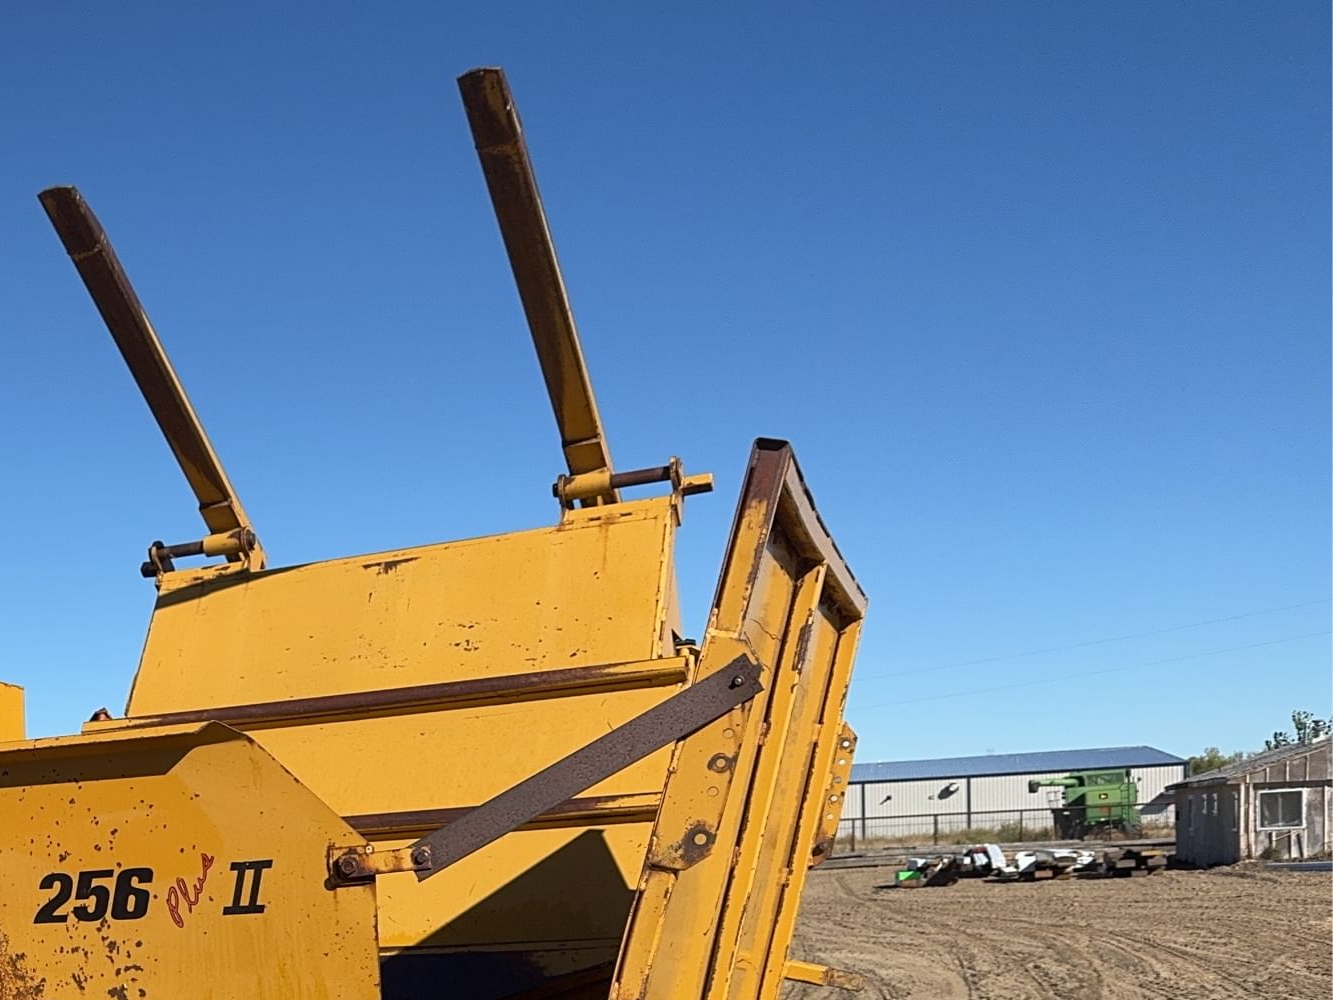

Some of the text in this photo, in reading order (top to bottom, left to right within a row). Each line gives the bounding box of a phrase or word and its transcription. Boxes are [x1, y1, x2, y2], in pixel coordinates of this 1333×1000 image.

[33, 853, 273, 928] 256 Plus II
